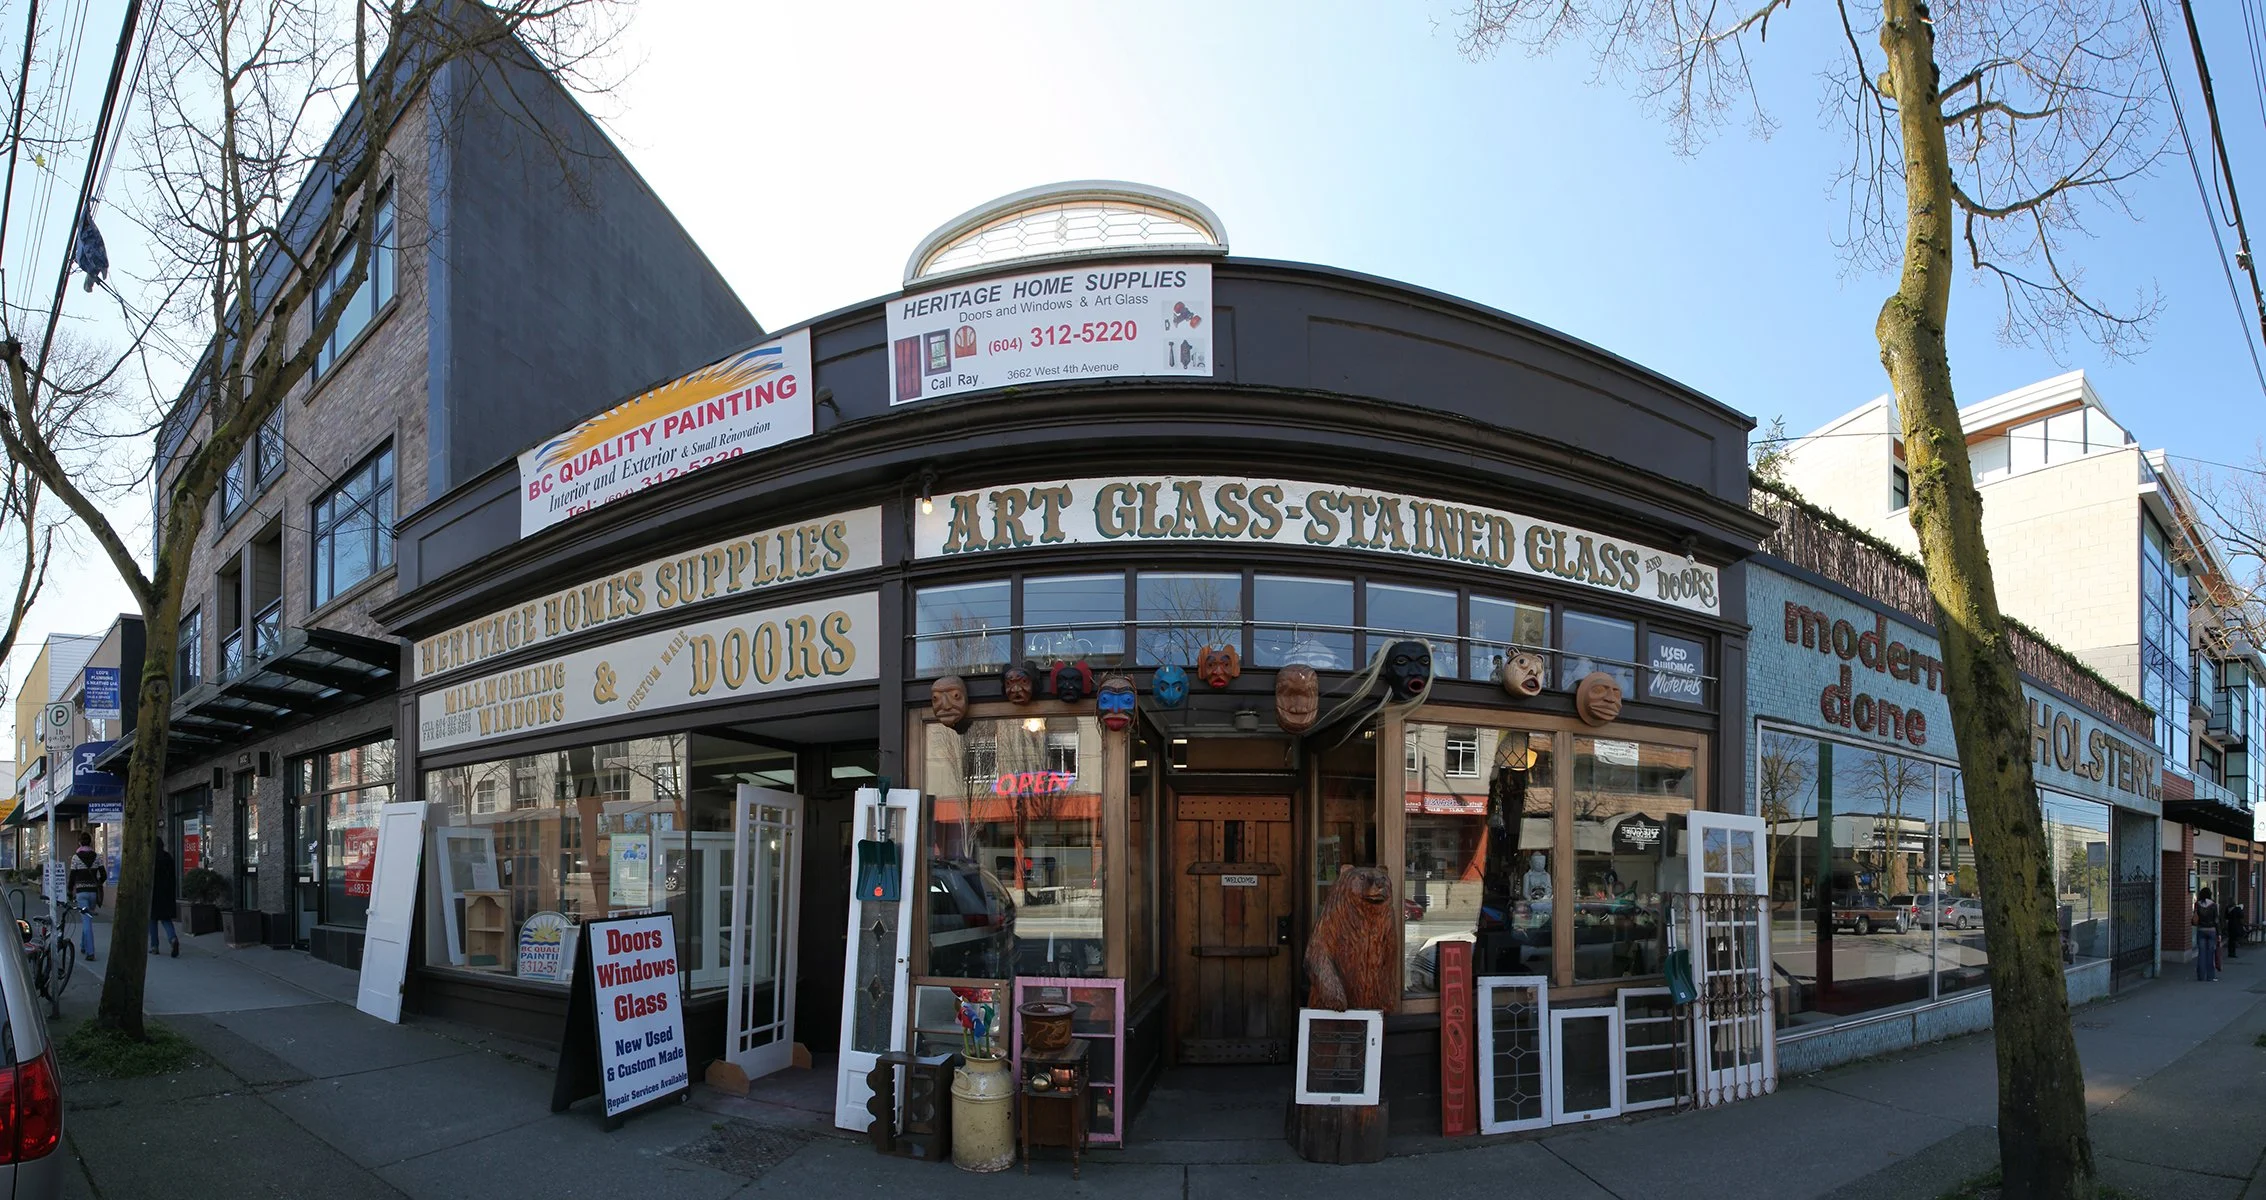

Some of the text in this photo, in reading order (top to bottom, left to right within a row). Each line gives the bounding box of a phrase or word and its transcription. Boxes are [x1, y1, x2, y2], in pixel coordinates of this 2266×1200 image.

[903, 270, 1187, 320] HERITAGE HOME SUPPLIES
[959, 292, 1149, 323] Doors and Windows & Art Glass
[988, 319, 1137, 356] (604) 312-5220
[931, 373, 979, 391] Call Ray
[1007, 361, 1119, 380] 3662 West 4th Avenue
[528, 374, 797, 501] BC QUALITY PAINTING
[549, 420, 771, 513] Interior and Exterior & Small Renovation
[942, 483, 1073, 554] ART
[1524, 524, 1640, 593] GLASS
[1645, 555, 1662, 573] AND
[1657, 567, 1718, 608] DOORS
[421, 520, 850, 677] HERITAGE HOMES SUPPLIES
[689, 610, 856, 697] DOORS
[1660, 645, 1687, 661] USED
[1785, 600, 1948, 695] modern
[444, 661, 566, 716] MILLWORKING
[593, 661, 620, 704] &
[627, 629, 689, 712] CUSTOM MADE
[1650, 671, 1701, 695] Materials
[55, 710, 65, 722] P
[478, 692, 565, 737] WINDOWS
[1821, 664, 1926, 746] done
[996, 770, 1071, 796] OPEN
[606, 929, 662, 955] Doors
[597, 958, 676, 989] Windows
[614, 992, 668, 1022] Glass
[615, 1026, 673, 1057] New Used
[607, 1046, 684, 1082] & Custom Made
[607, 1072, 688, 1110] Repair Services Available
